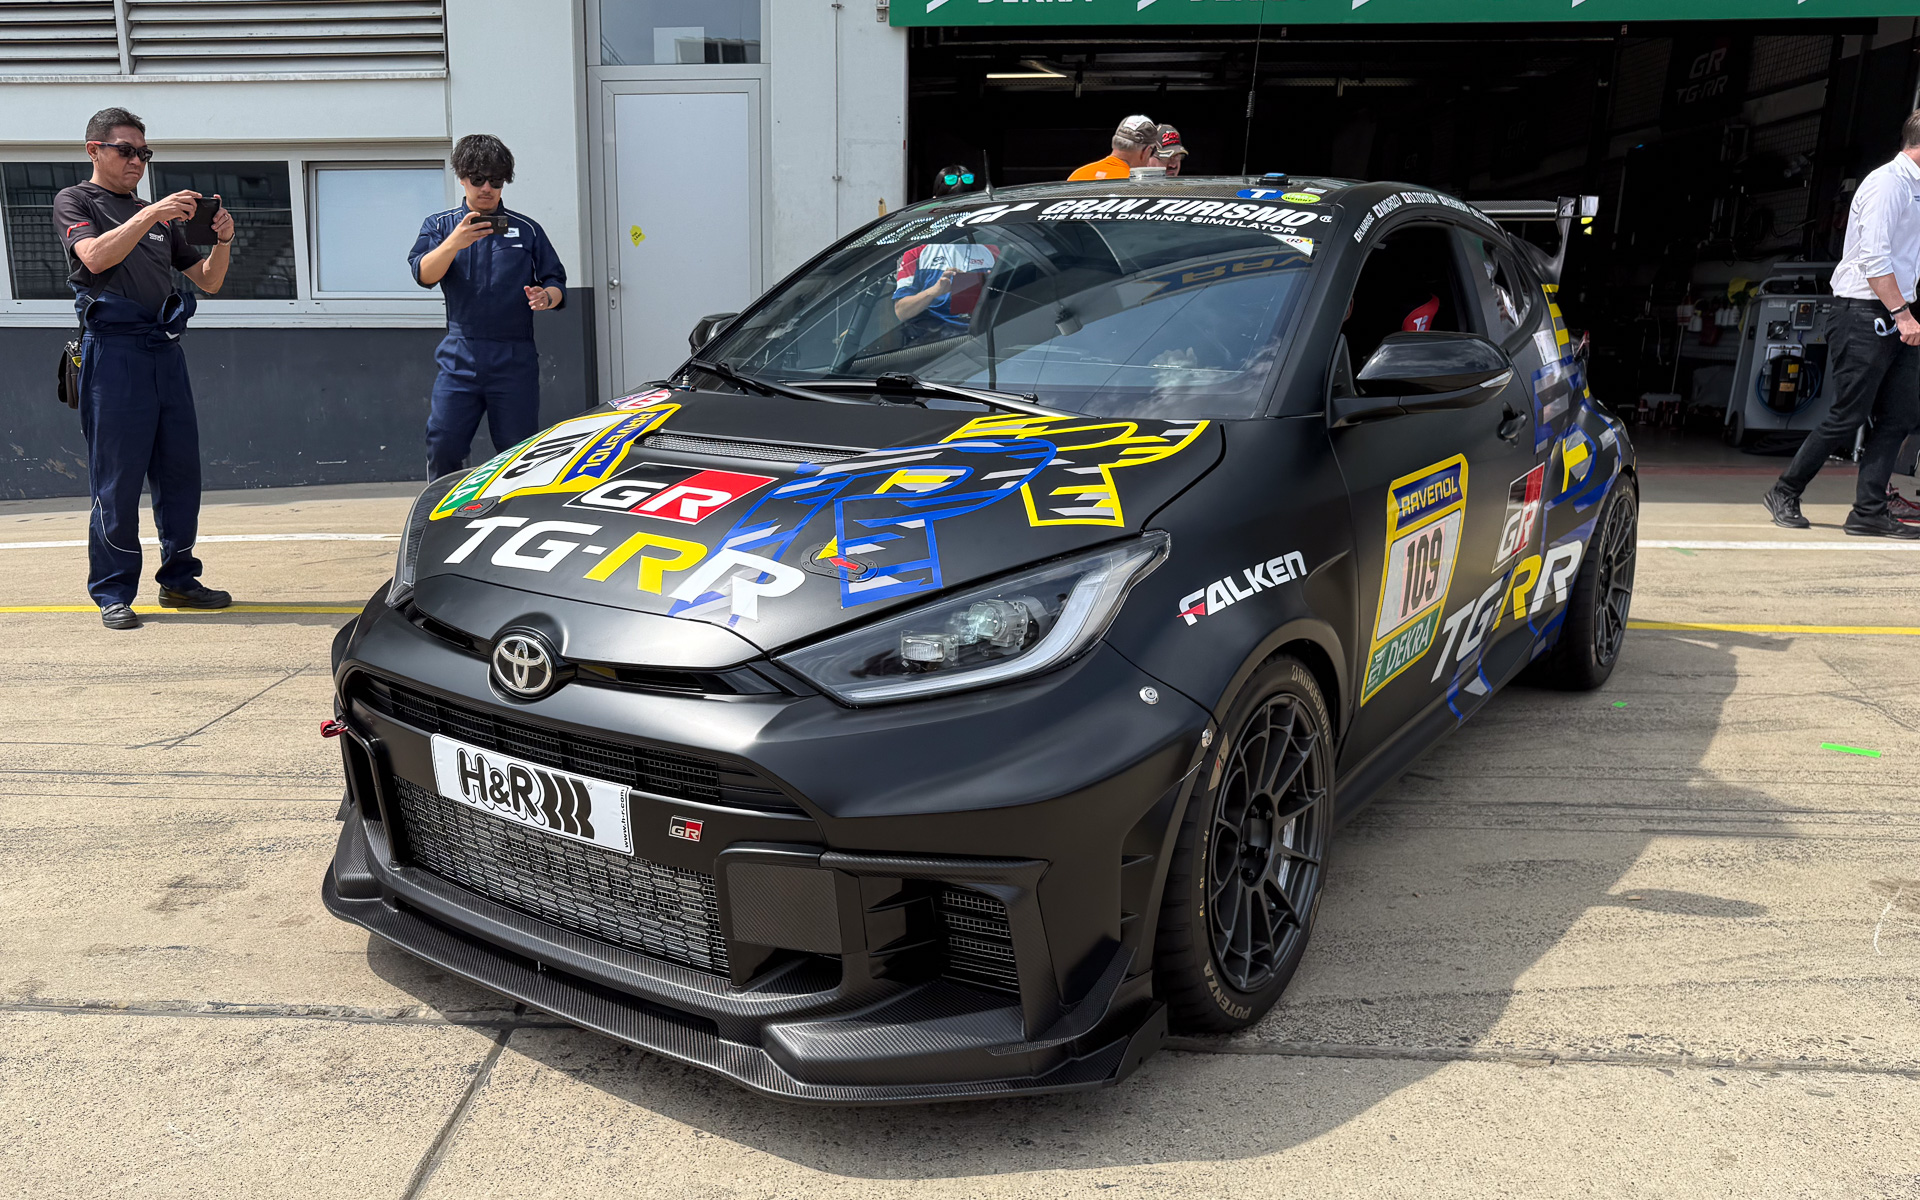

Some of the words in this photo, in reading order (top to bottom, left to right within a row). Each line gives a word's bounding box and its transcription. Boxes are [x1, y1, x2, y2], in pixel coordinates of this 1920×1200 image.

[1041, 198, 1150, 216] GRAN
[1145, 199, 1319, 227] TURISMO
[1070, 213, 1112, 221] REAL
[1115, 213, 1187, 223] DRIVING
[1190, 215, 1298, 235] SIMULATOR
[577, 412, 658, 474] RAVENOL
[580, 479, 733, 520] GR
[1401, 476, 1459, 517] RAVENOL
[1496, 500, 1539, 564] GR
[443, 516, 807, 623] TG-RR
[1177, 550, 1308, 626] FALKEN
[1400, 526, 1443, 619] 109
[1384, 616, 1432, 676] DEKRA
[1291, 664, 1330, 745] BRIDGESTONE
[458, 748, 541, 821] H&R
[671, 825, 700, 840] GR
[1203, 958, 1252, 1020] POTENZA
